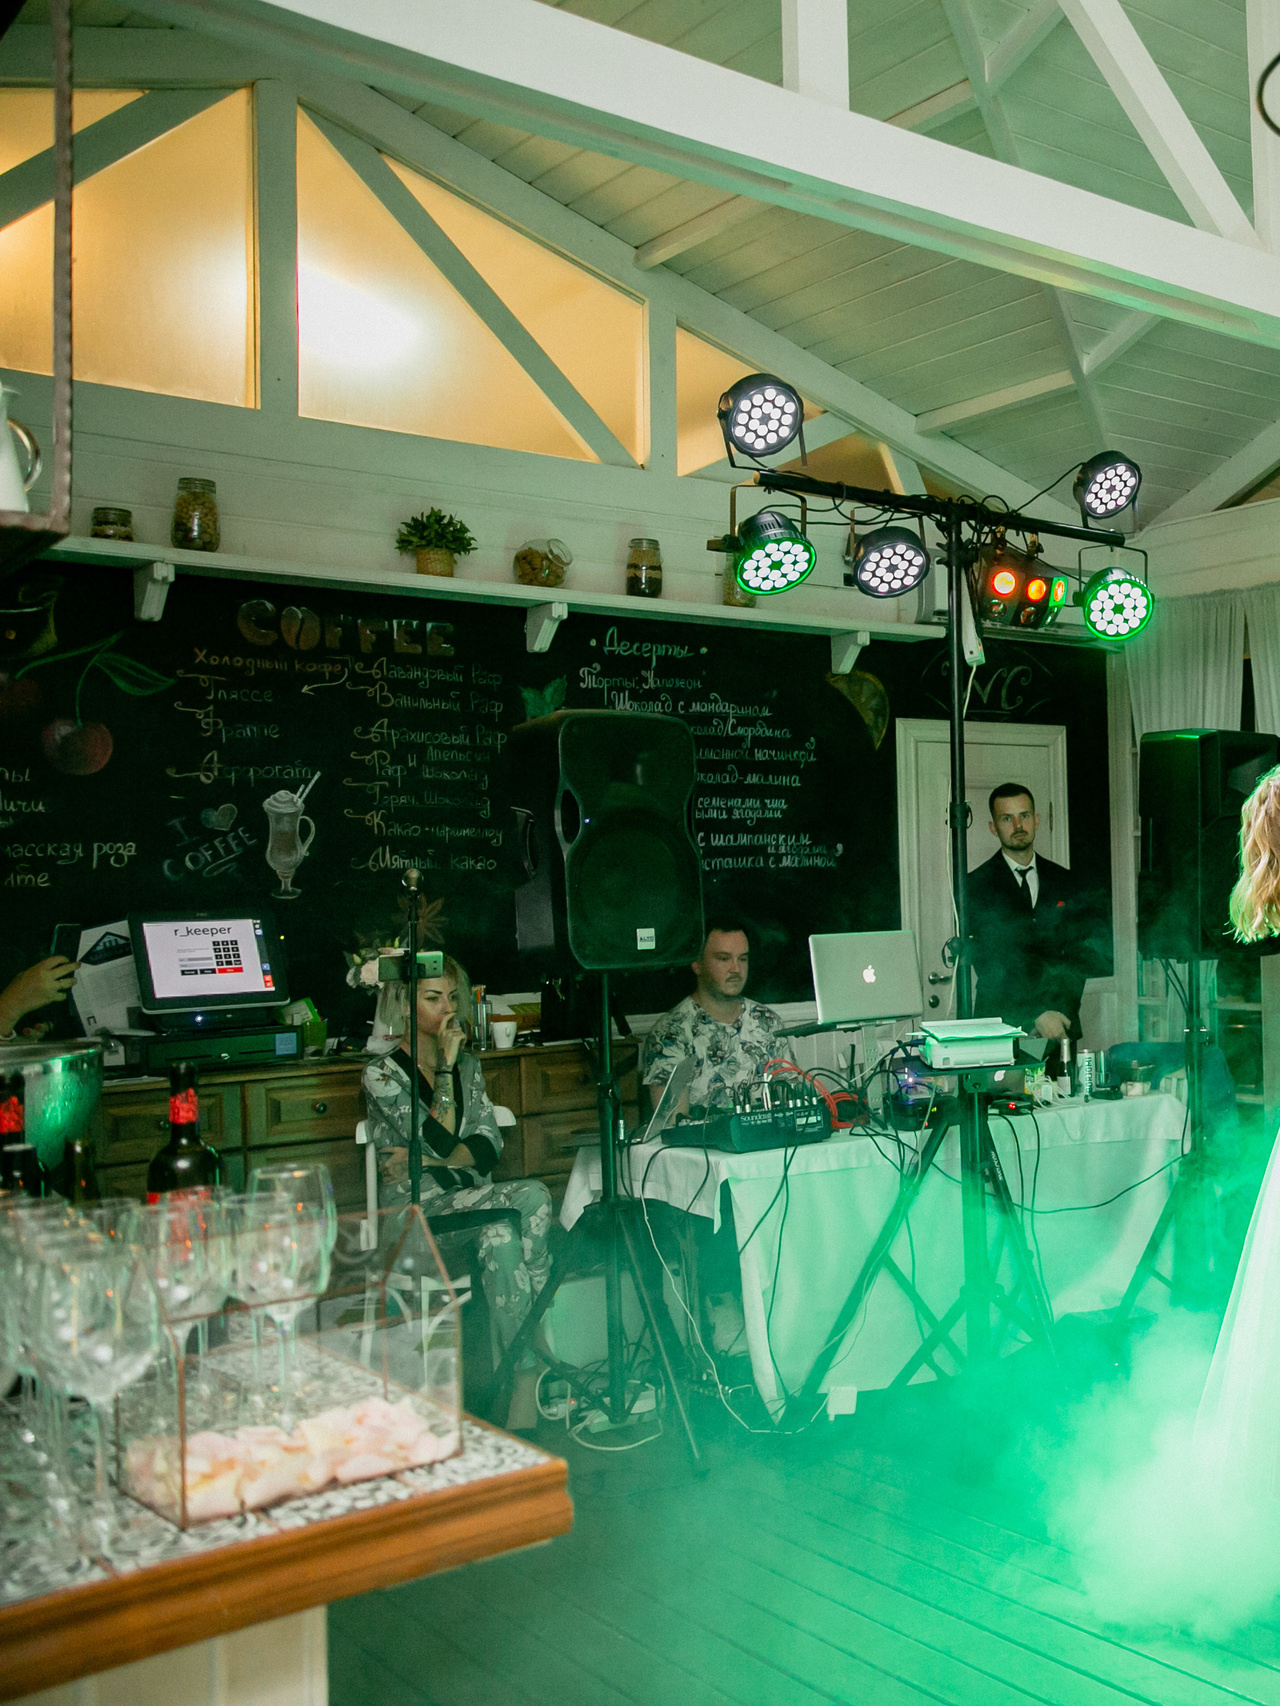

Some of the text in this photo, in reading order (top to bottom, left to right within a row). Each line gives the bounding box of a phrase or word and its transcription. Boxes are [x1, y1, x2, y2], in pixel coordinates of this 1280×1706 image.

[236, 599, 455, 657] COFFEE
[603, 626, 695, 669] Десерты
[295, 659, 342, 681] кофе
[356, 657, 503, 691] Лавандовый Раф
[354, 681, 503, 723] Ванильный Раф
[611, 690, 774, 717] Шоколад с мандарином
[355, 718, 508, 754] Арахисовый Раф
[690, 718, 792, 748] колад/Смородина
[359, 750, 407, 788] Раф
[697, 764, 802, 786] колад-малина
[0, 789, 46, 812] ичи
[731, 809, 782, 826] ягодами
[162, 826, 258, 881] COFFEE
[710, 832, 812, 847] шампанским
[92, 841, 138, 871] роза
[358, 845, 497, 872] Мятный какао
[174, 926, 233, 938] r_keeper
